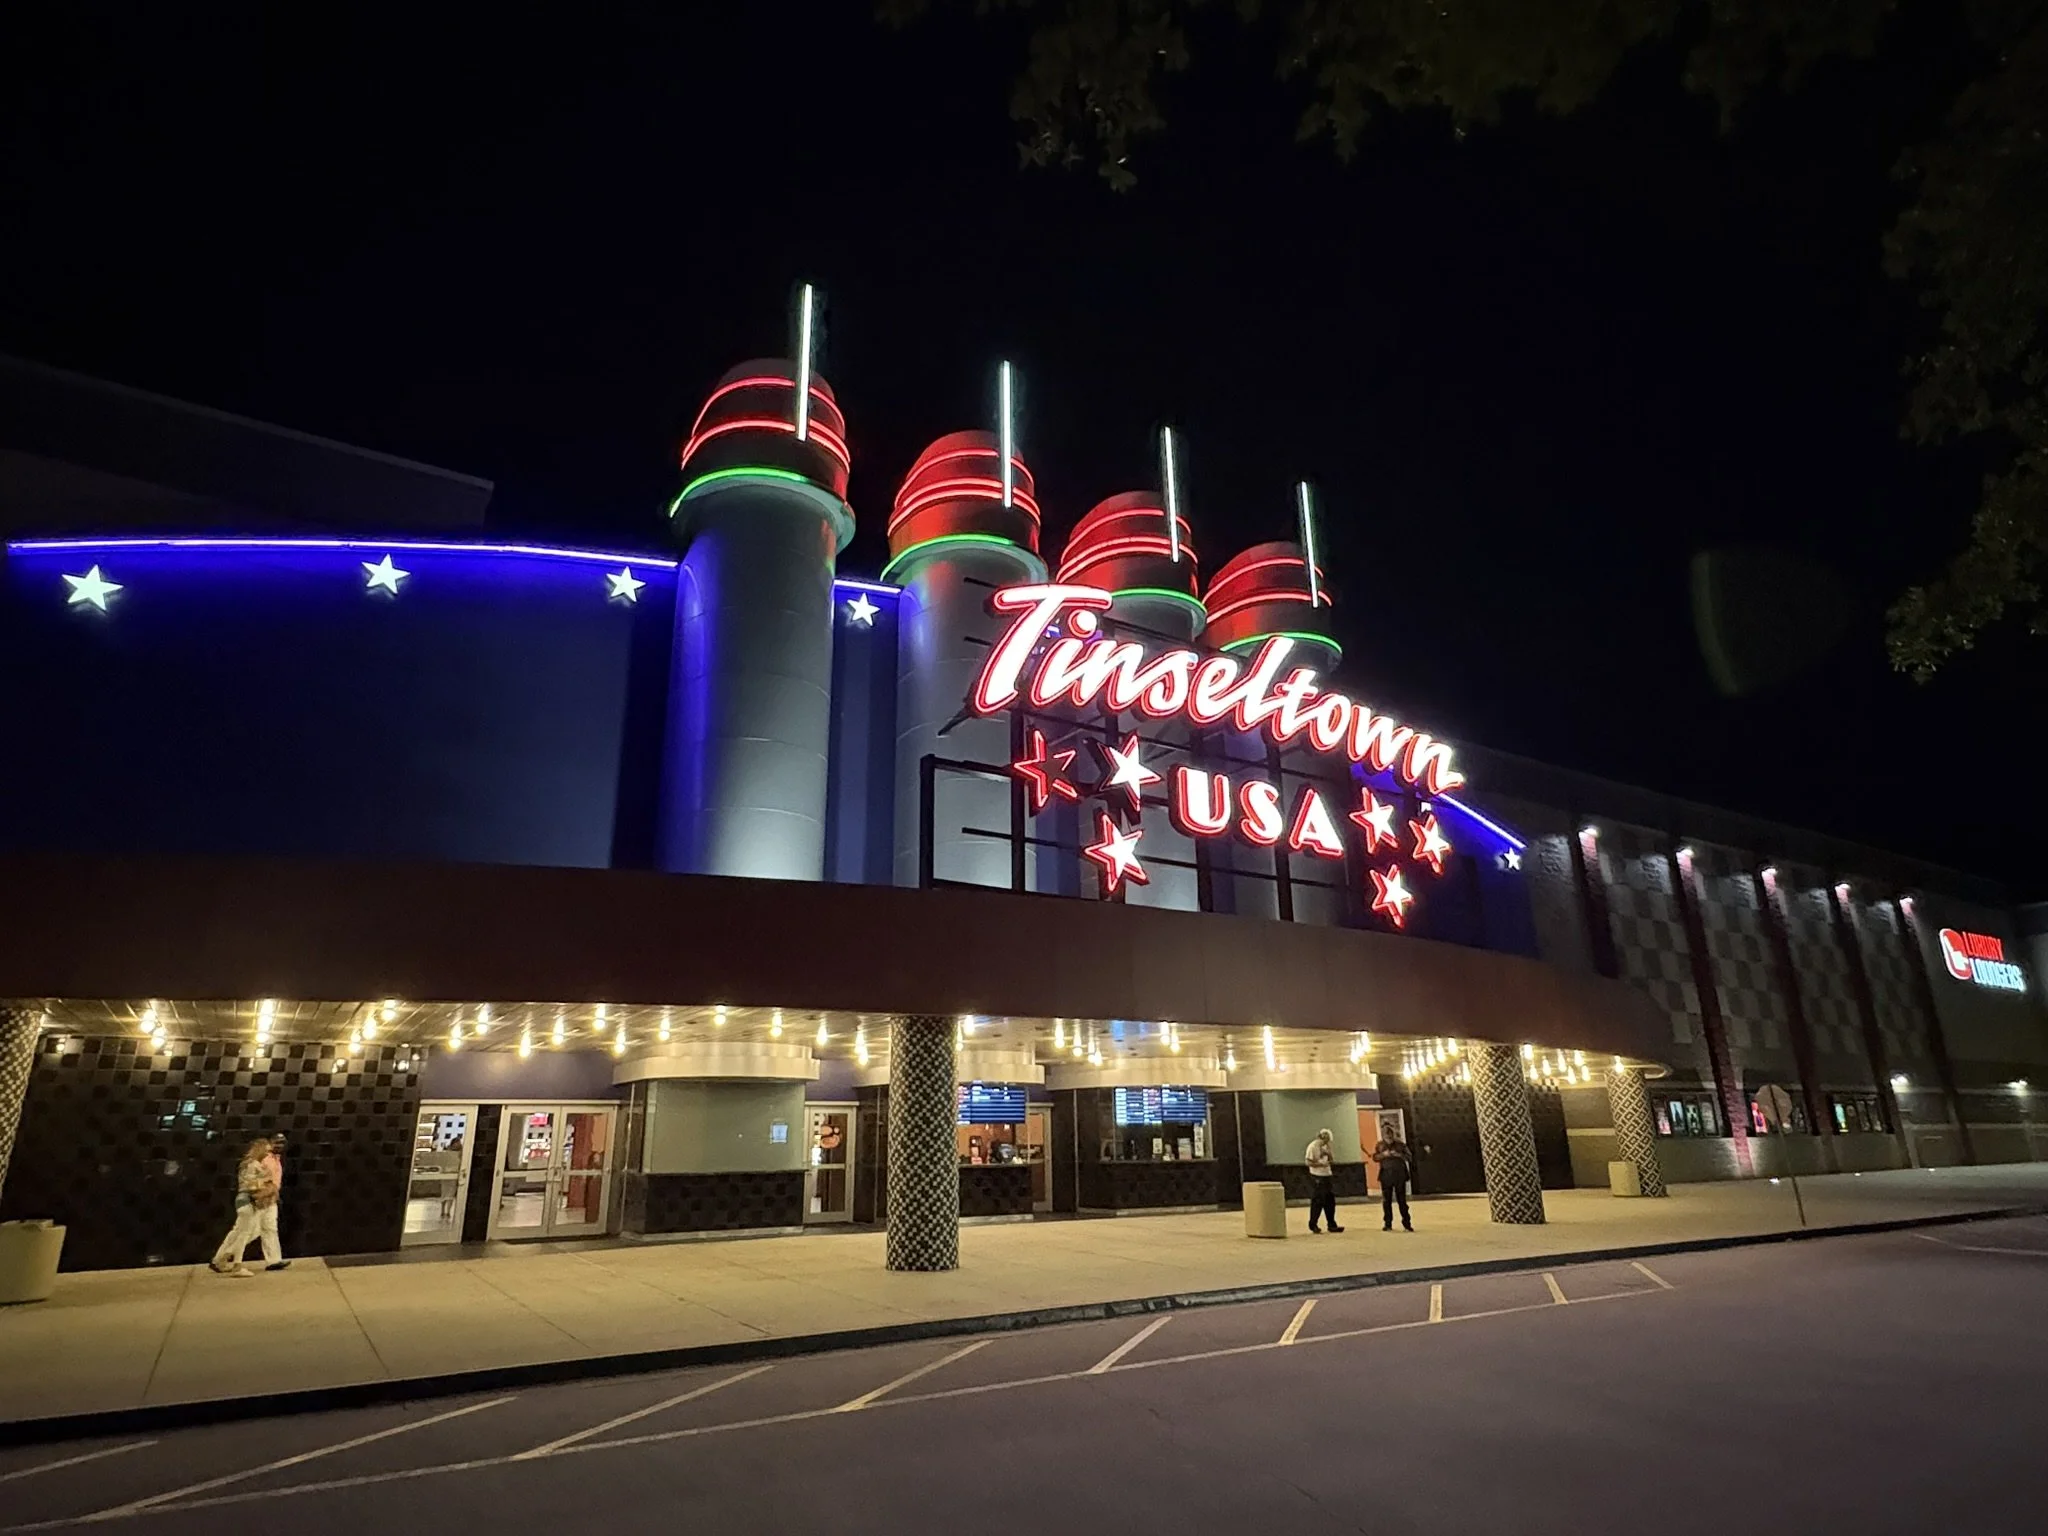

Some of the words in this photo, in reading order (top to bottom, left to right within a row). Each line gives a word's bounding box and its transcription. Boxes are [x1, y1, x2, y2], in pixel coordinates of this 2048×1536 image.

[975, 584, 1464, 793] Tinseltown
[1176, 766, 1344, 857] USA
[1962, 931, 2003, 960] LUXURY
[1969, 958, 2026, 992] LOUNGERS
